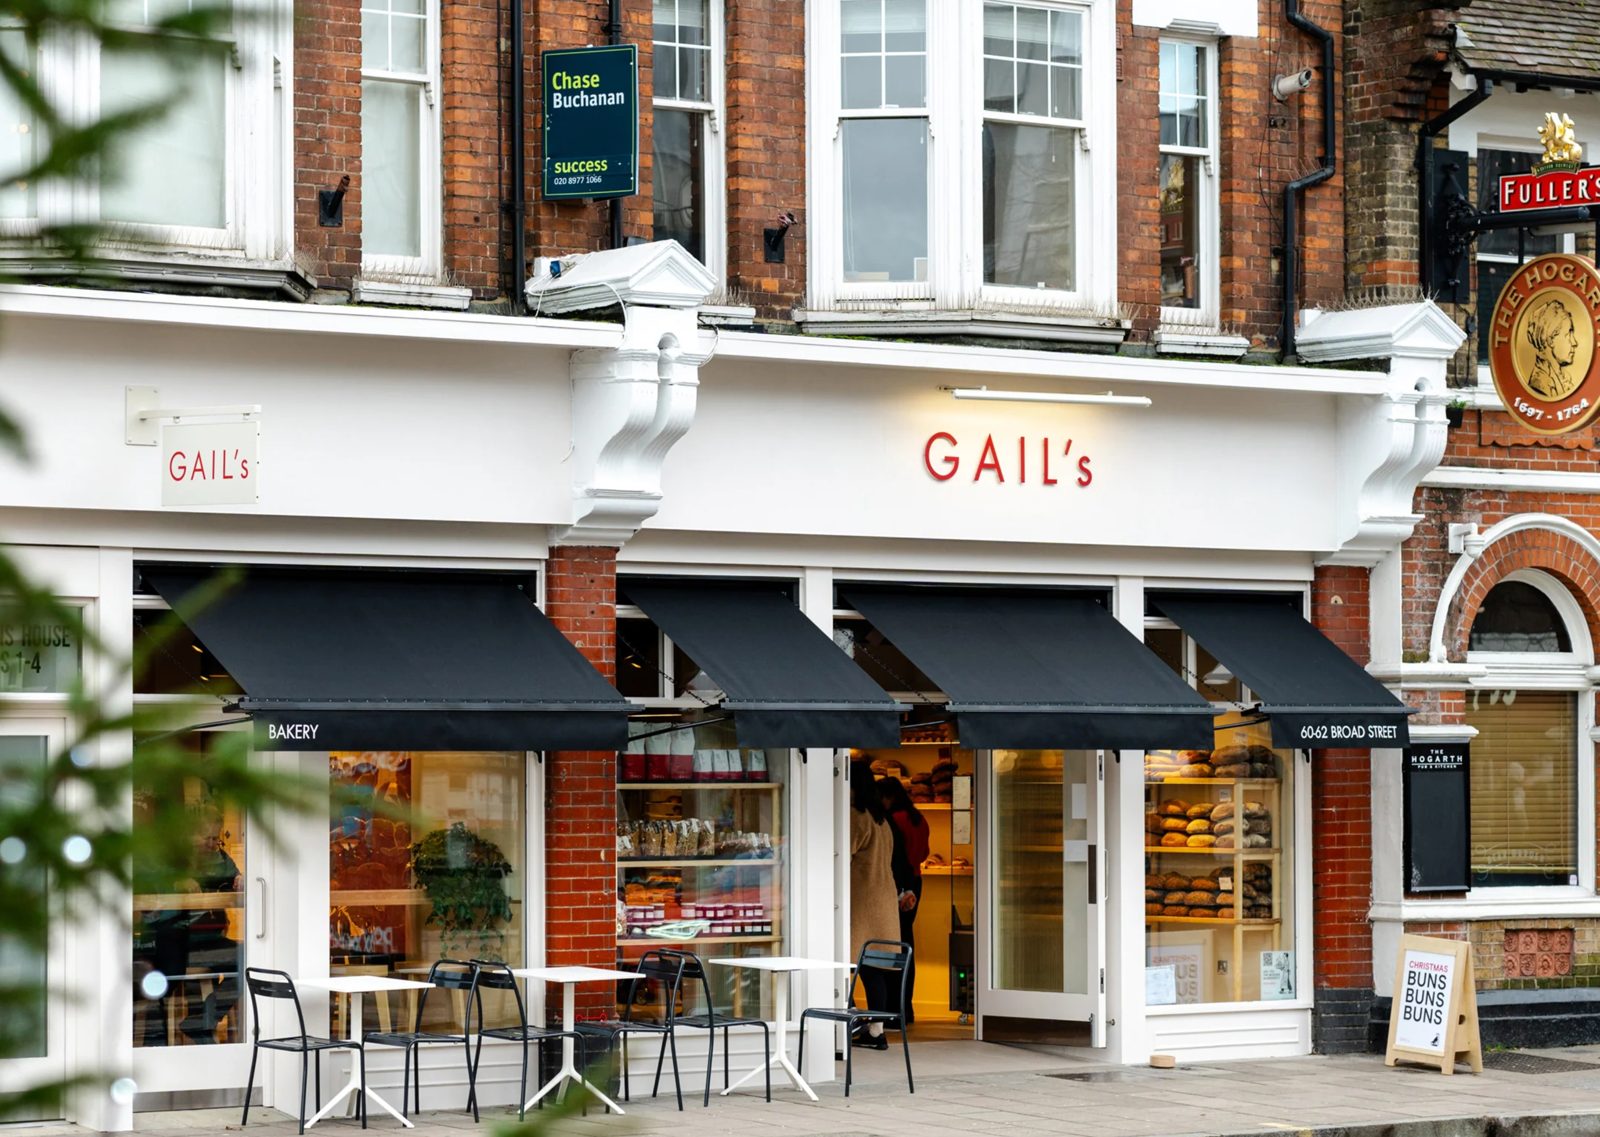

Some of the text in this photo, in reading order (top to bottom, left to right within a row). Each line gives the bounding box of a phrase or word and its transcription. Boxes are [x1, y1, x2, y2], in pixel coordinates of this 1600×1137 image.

[552, 72, 600, 90] Chase
[553, 91, 625, 108] Buchanan
[555, 160, 608, 174] success
[554, 175, 602, 185] 020 8977 1066
[1504, 174, 1600, 205] FULLER'S
[1495, 286, 1523, 347] THE
[1514, 397, 1544, 420] 1697
[1556, 398, 1589, 421] 1764
[169, 449, 249, 481] GAIL's
[924, 431, 1093, 487] GAIL's
[22, 624, 70, 647] HOUSE
[16, 651, 41, 674] 1-4
[268, 724, 319, 739] BAKERY
[1300, 725, 1398, 739] 60-62 BROAD STREET
[1411, 755, 1463, 763] HOGARTH
[1408, 960, 1449, 973] CHRISTMAS
[1407, 970, 1447, 990] BUNS
[1405, 987, 1445, 1008] BUNS
[1403, 1005, 1442, 1025] BUNS
